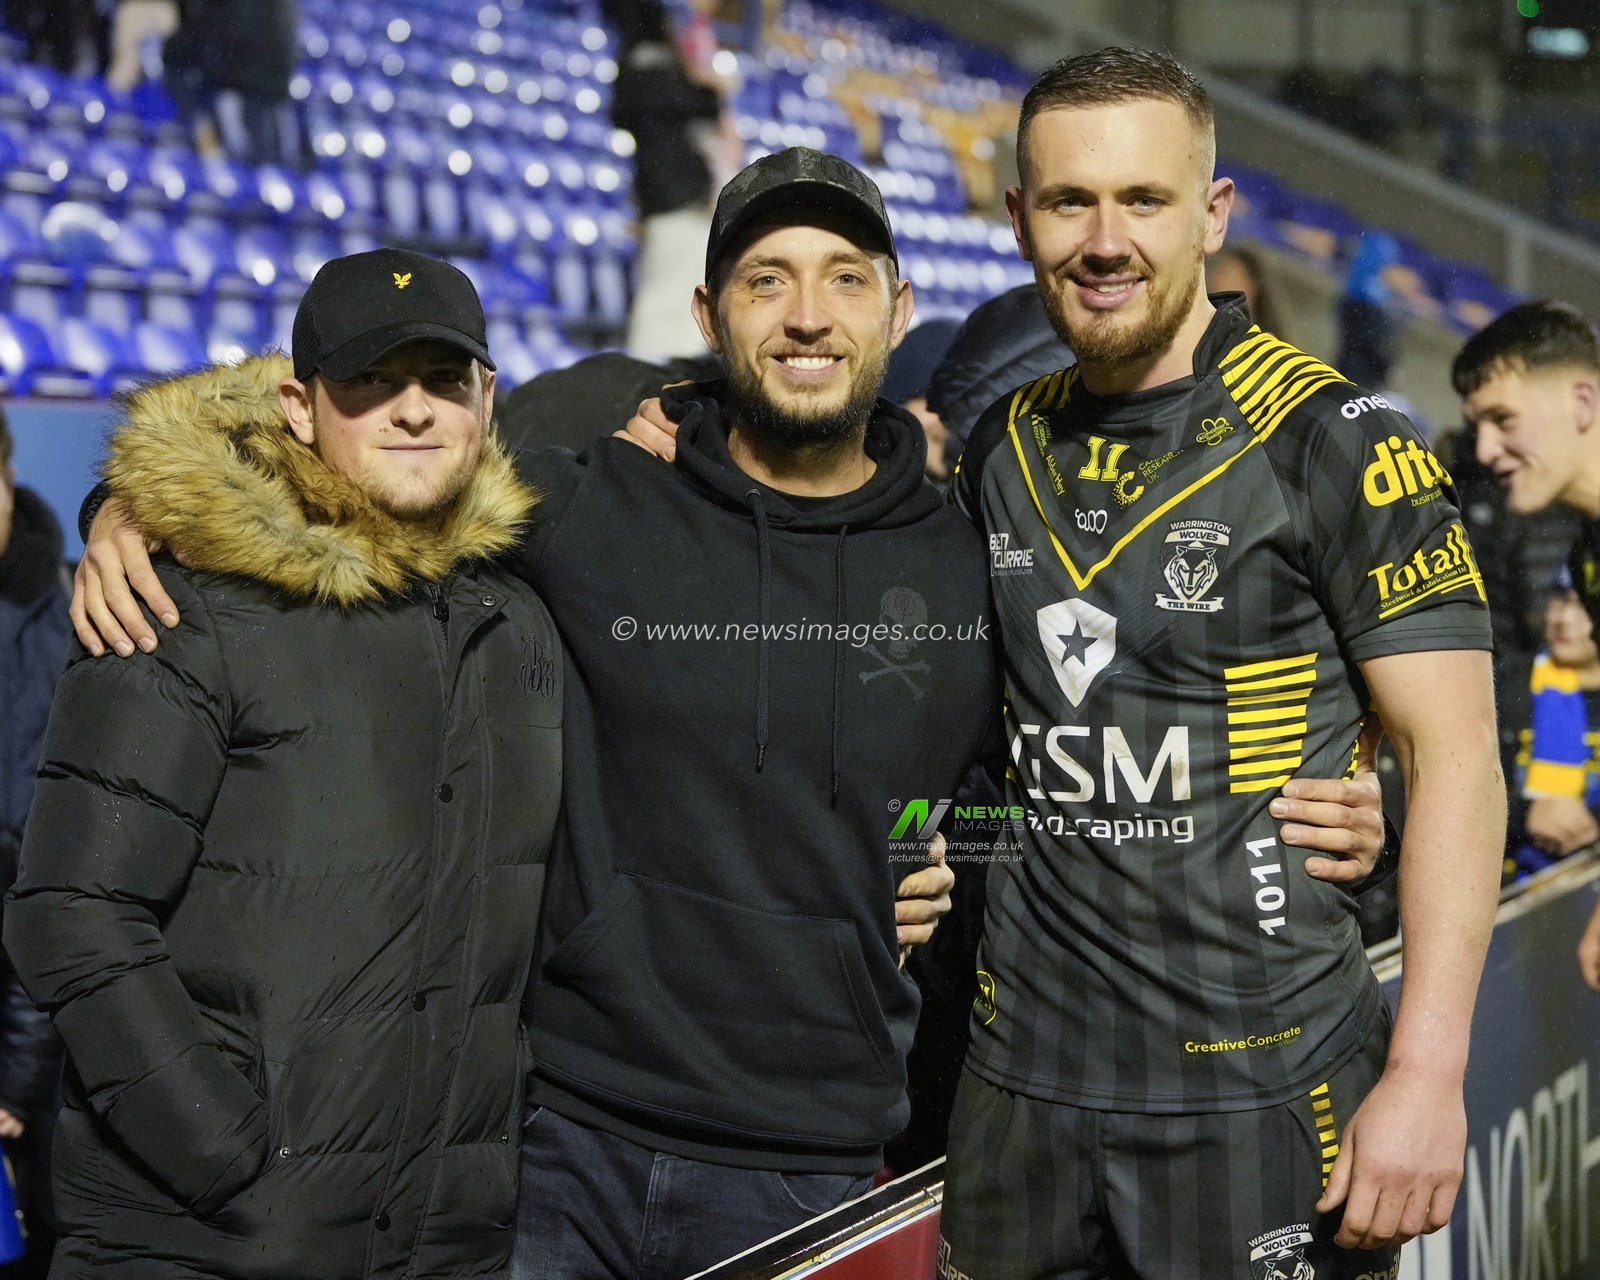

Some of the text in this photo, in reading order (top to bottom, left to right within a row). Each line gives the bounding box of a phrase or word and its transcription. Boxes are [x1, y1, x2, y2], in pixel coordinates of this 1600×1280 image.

[1078, 436, 1130, 482] 11
[1046, 453, 1058, 478] Alder
[1054, 473, 1066, 496] Hey
[1146, 472, 1160, 484] UK
[1170, 520, 1232, 535] WARRINGTON
[1179, 531, 1219, 541] WOLVES
[1380, 589, 1415, 610] Steelwork
[1422, 569, 1459, 591] Fabrication
[1167, 601, 1211, 611] THE WIRE
[1246, 836, 1287, 936] 1011
[1185, 1026, 1301, 1053] CreativeConcrete
[1248, 1222, 1310, 1248] WARRINGTON
[1262, 1234, 1302, 1254] WOLVES
